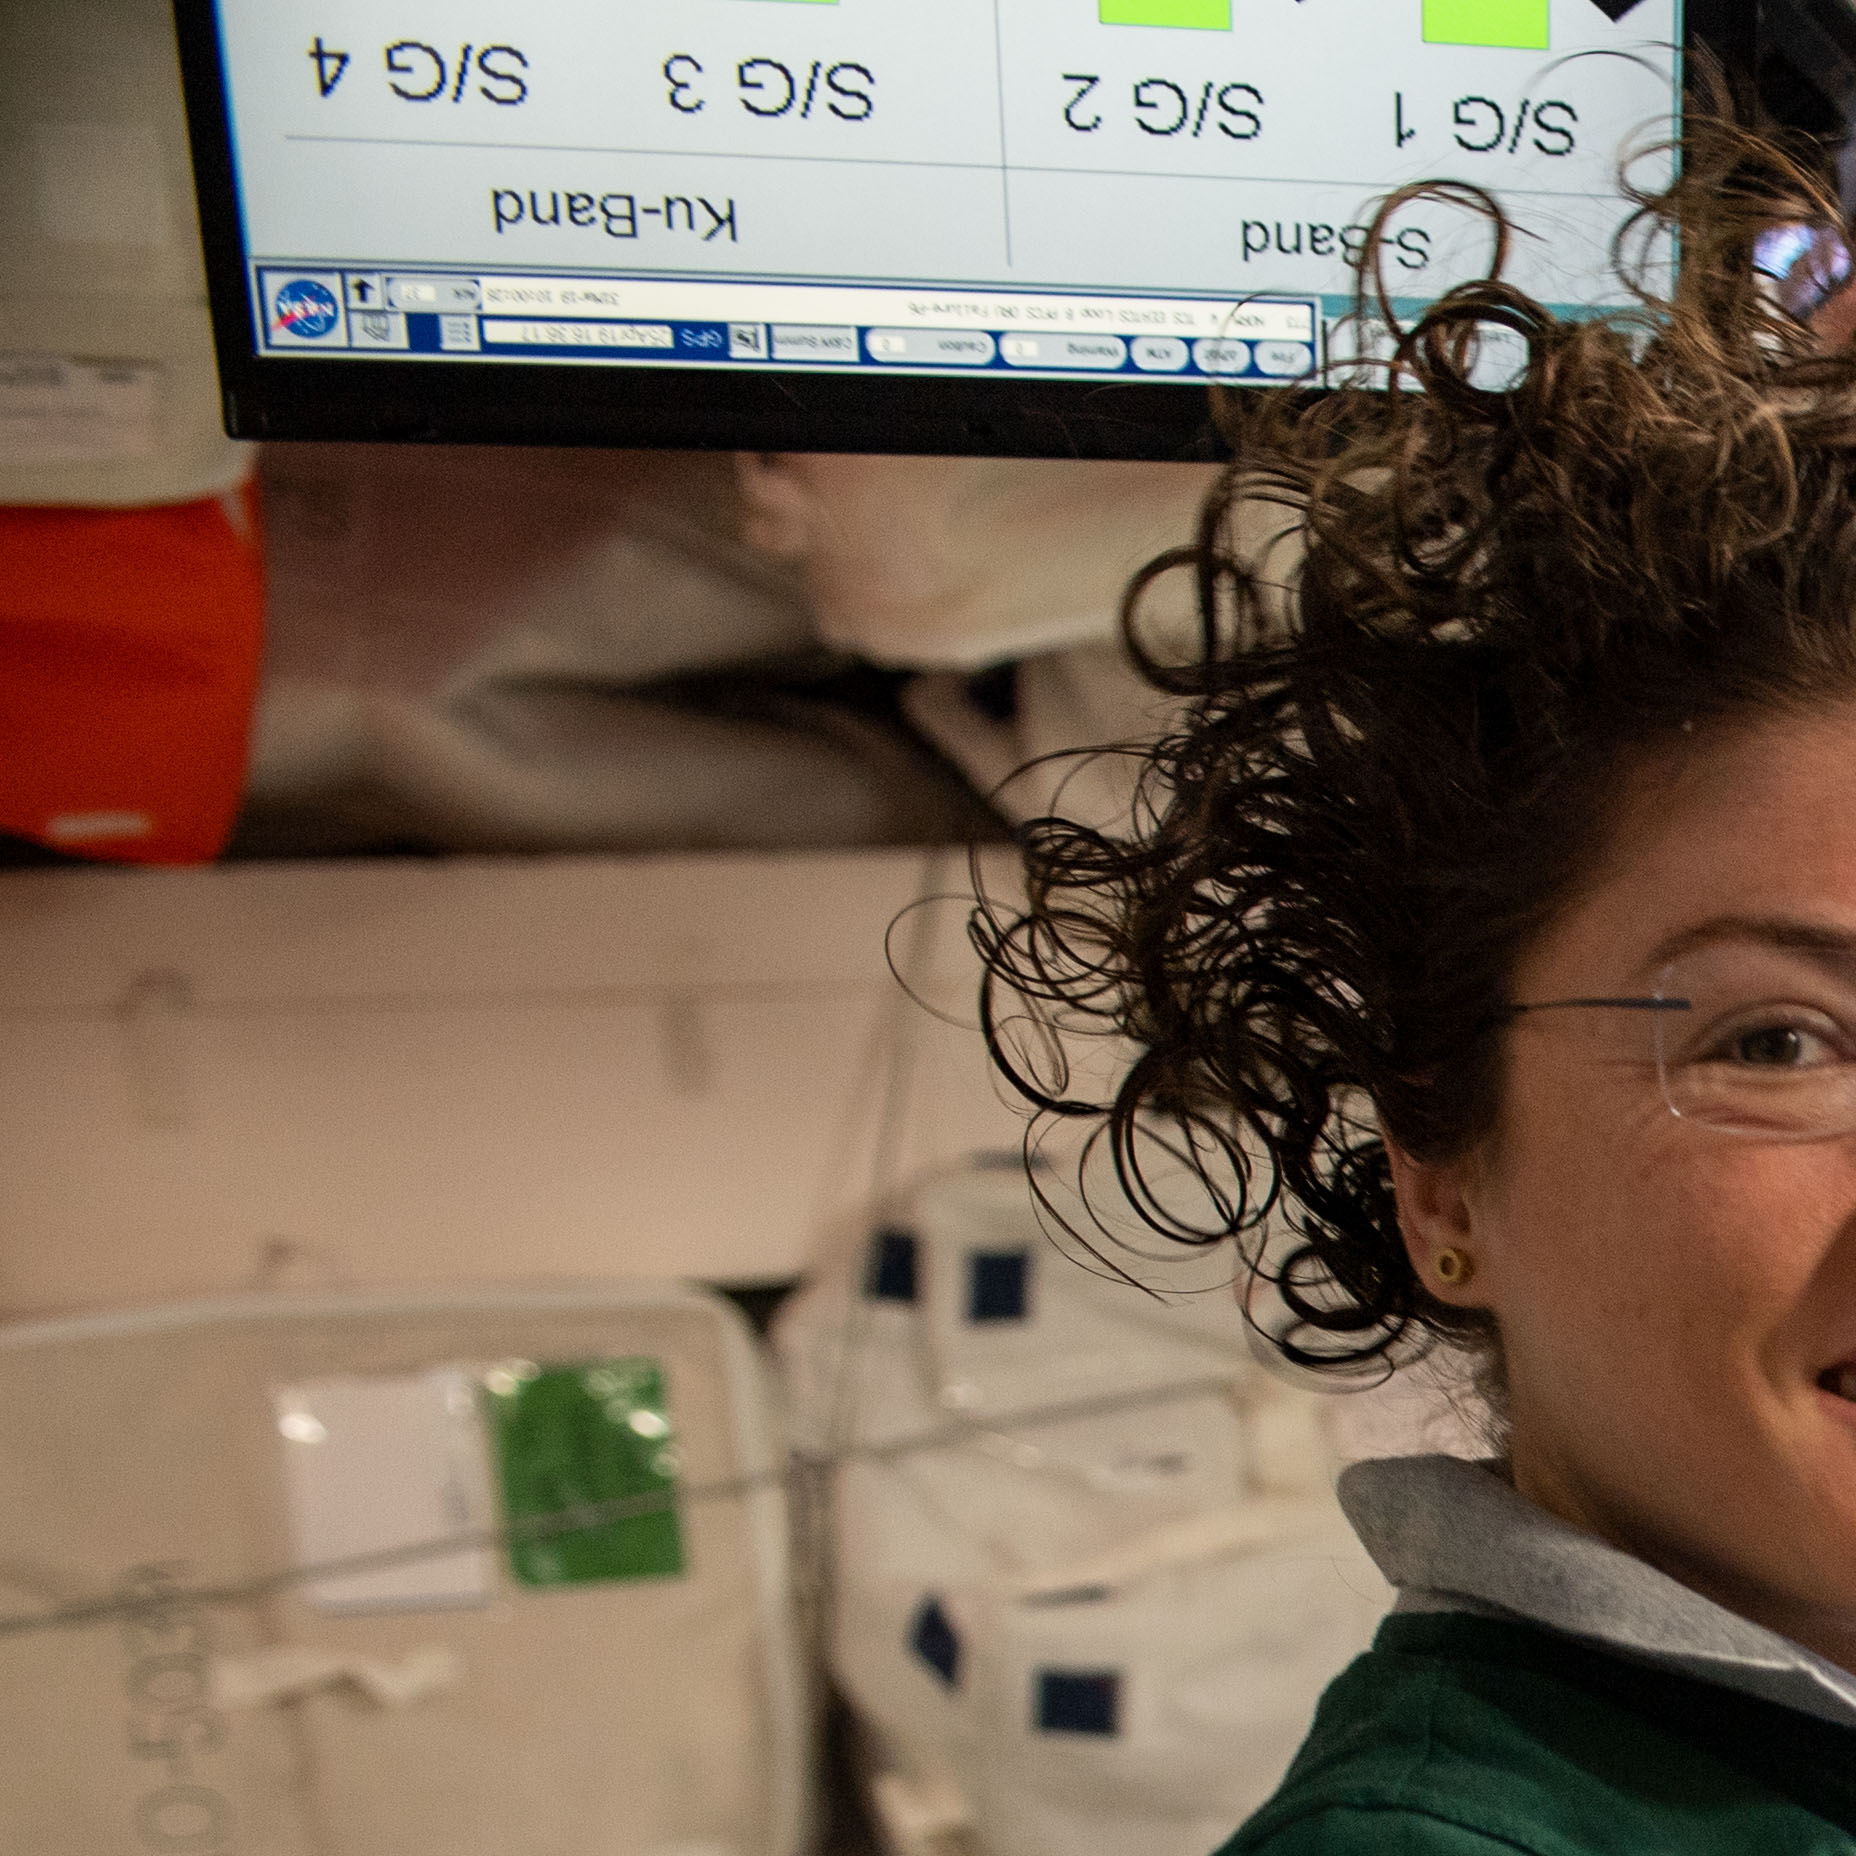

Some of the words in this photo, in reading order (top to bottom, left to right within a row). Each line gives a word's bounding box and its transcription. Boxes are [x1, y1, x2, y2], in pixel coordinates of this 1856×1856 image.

[308, 37, 350, 98] 4
[384, 41, 529, 106] S/G
[662, 54, 705, 112] 3
[738, 58, 875, 120] S/G
[1062, 73, 1101, 133] 2
[1133, 78, 1264, 139] S/G
[1394, 91, 1416, 148] 1
[1452, 95, 1579, 156] S/G
[491, 187, 740, 242] Ku-Band
[1241, 219, 1431, 270] S-Band
[680, 327, 725, 348] GPS
[1081, 305, 1113, 321] Loop
[936, 339, 988, 353] Caution
[1066, 342, 1119, 358] Warning
